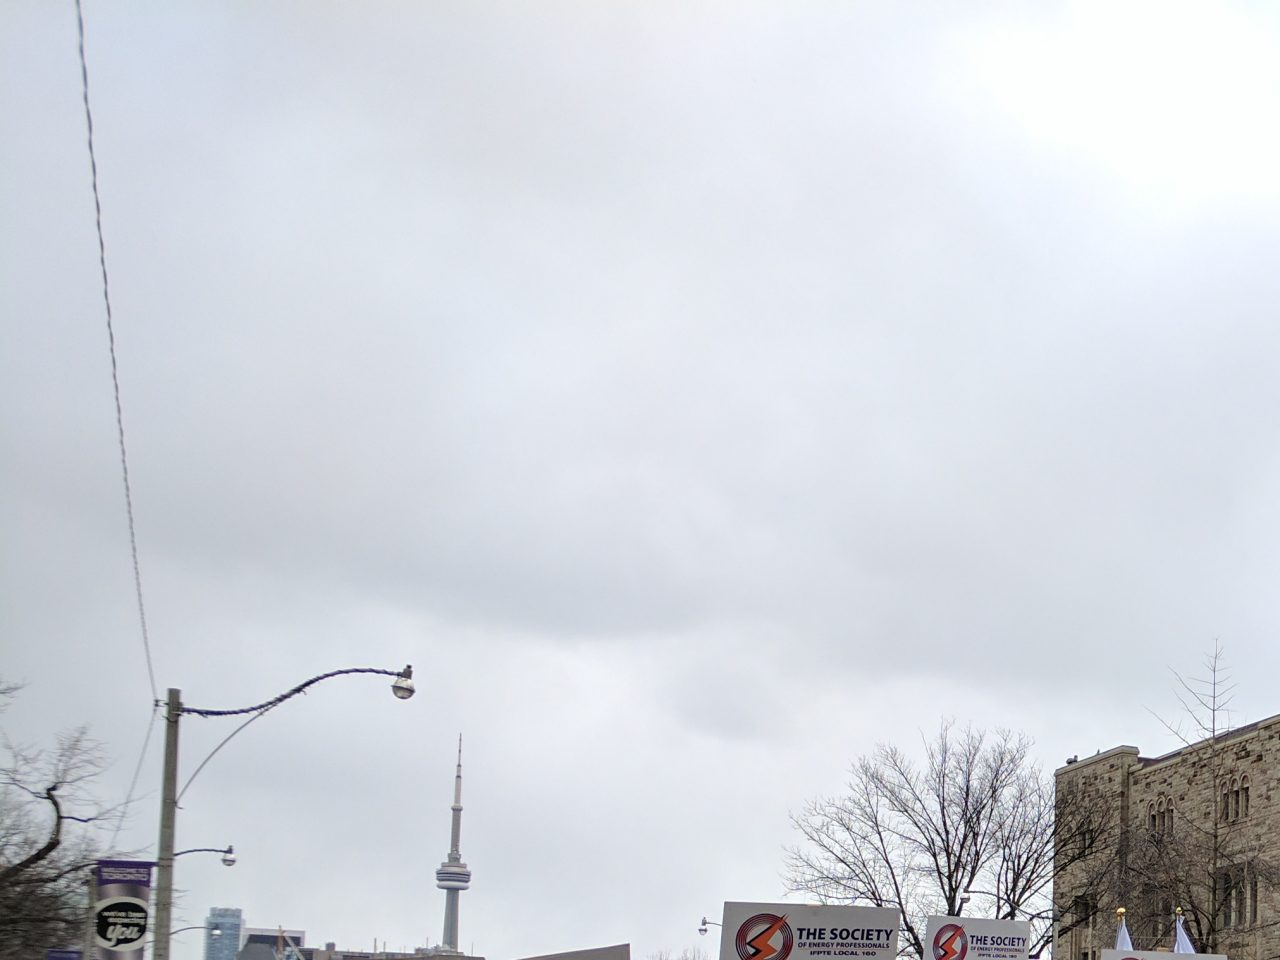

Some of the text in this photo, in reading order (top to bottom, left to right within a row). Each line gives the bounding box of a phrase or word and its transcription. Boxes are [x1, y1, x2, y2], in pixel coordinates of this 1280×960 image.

[797, 927, 894, 941] THE SOCIETY
[970, 935, 1027, 947] THE SOCIETY
